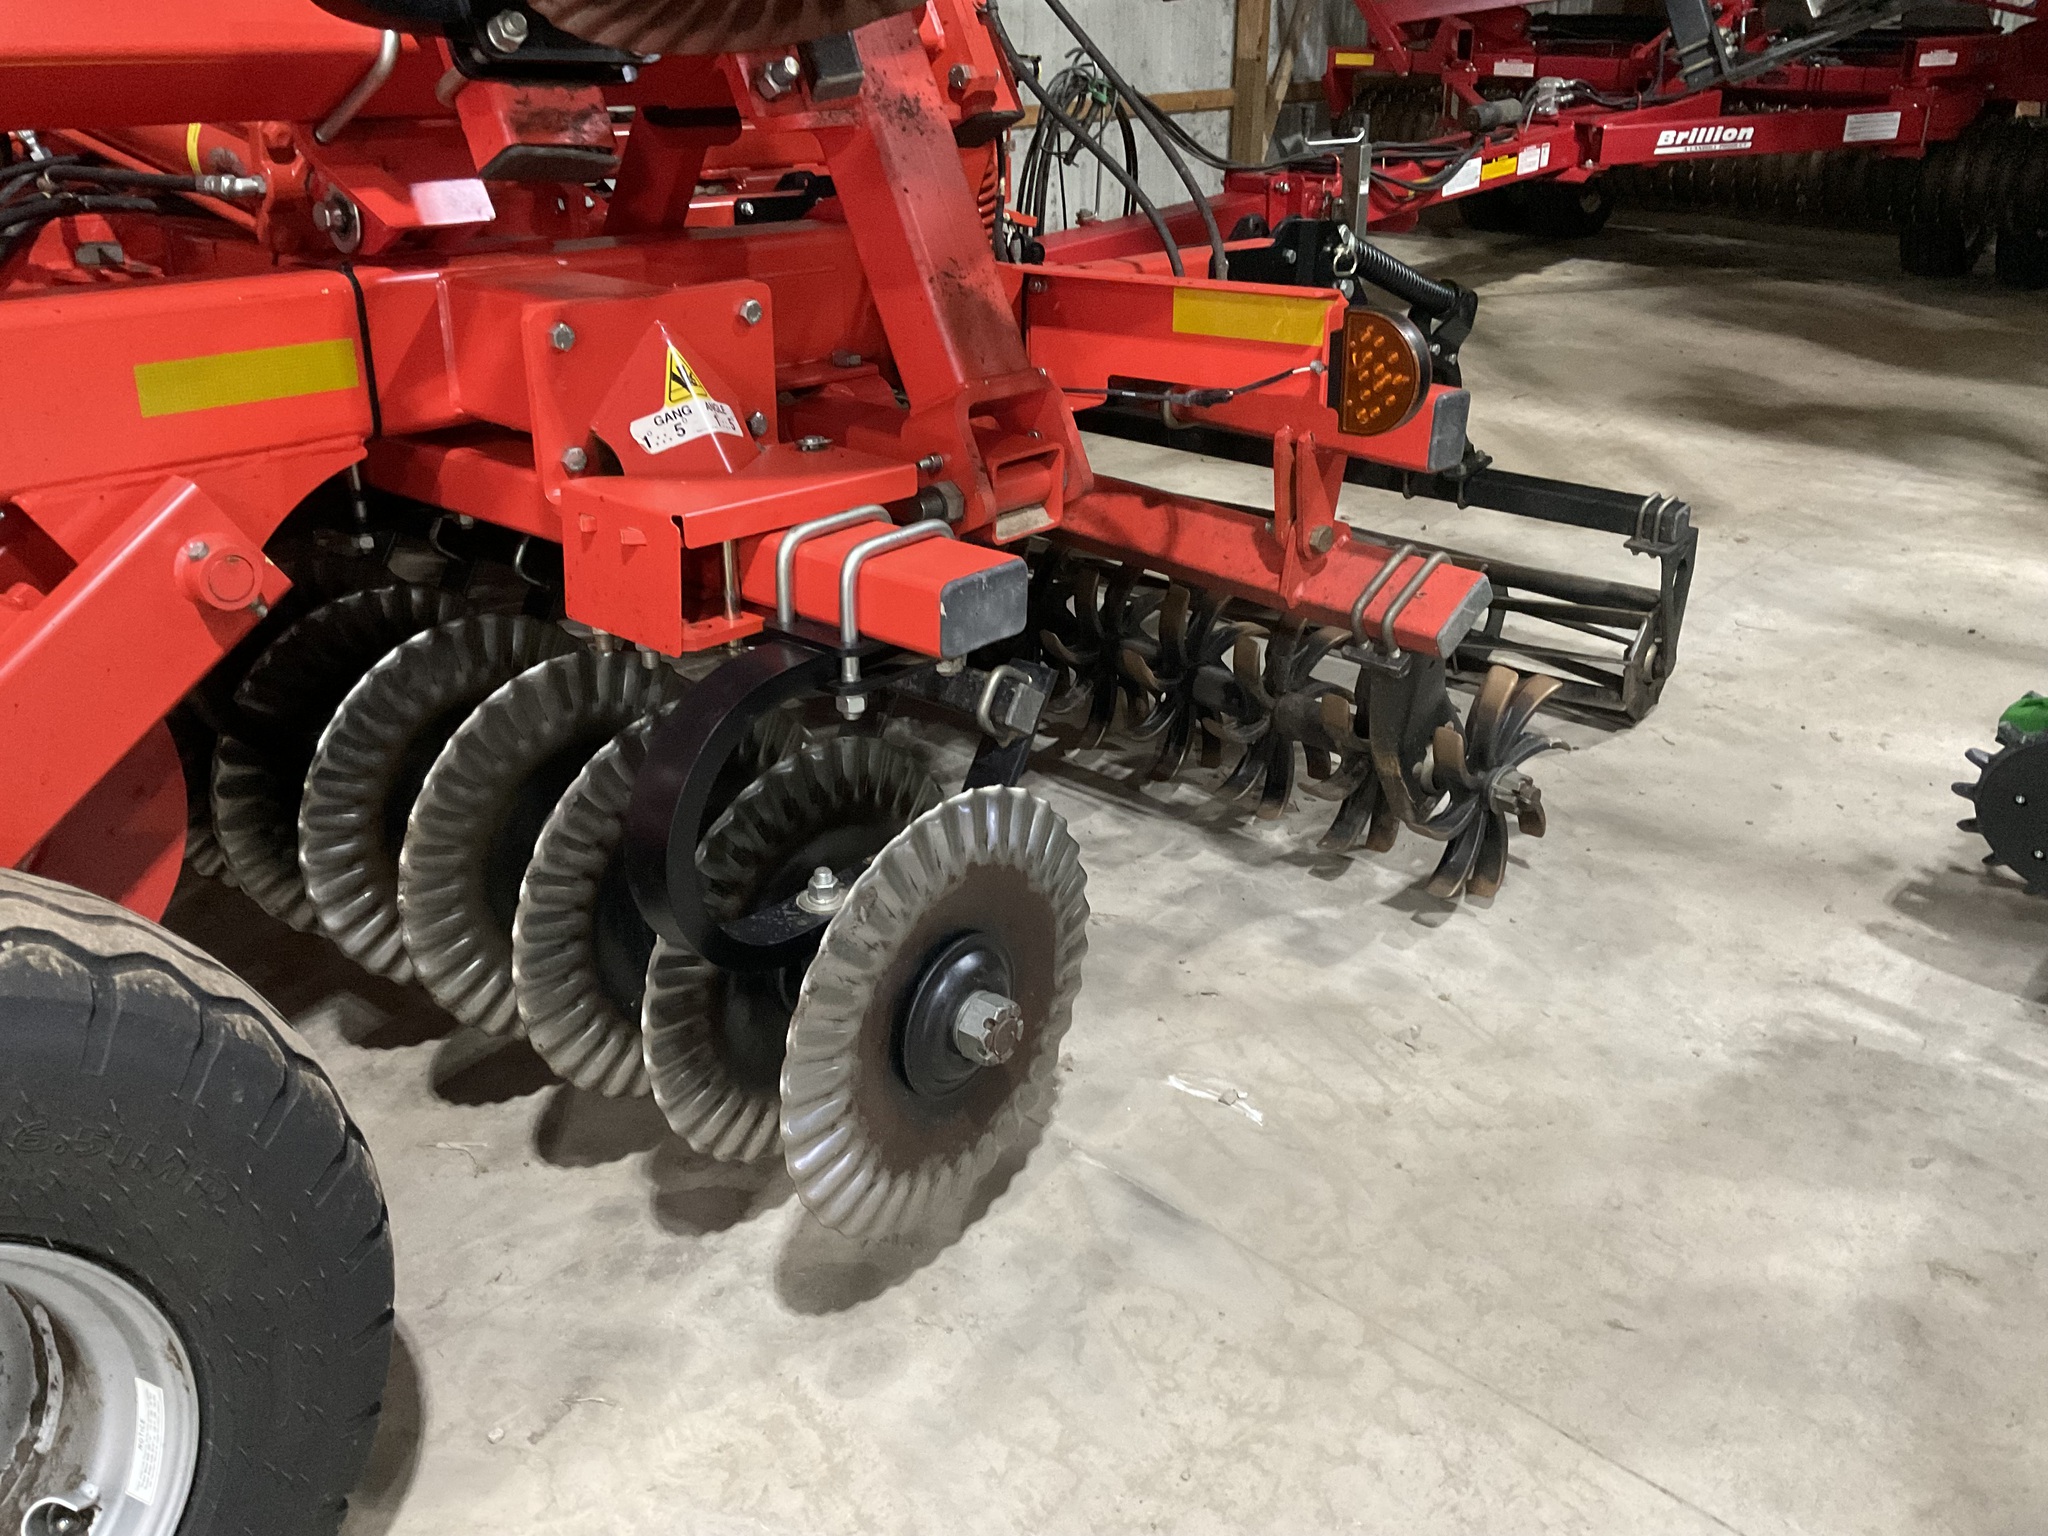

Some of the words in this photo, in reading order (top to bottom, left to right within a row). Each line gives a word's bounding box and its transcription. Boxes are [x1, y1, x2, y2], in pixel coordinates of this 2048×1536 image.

[1656, 125, 1754, 146] Brillion
[653, 405, 692, 426] GANG
[704, 401, 727, 415] ANGLE
[138, 1418, 146, 1451] NOTICE
